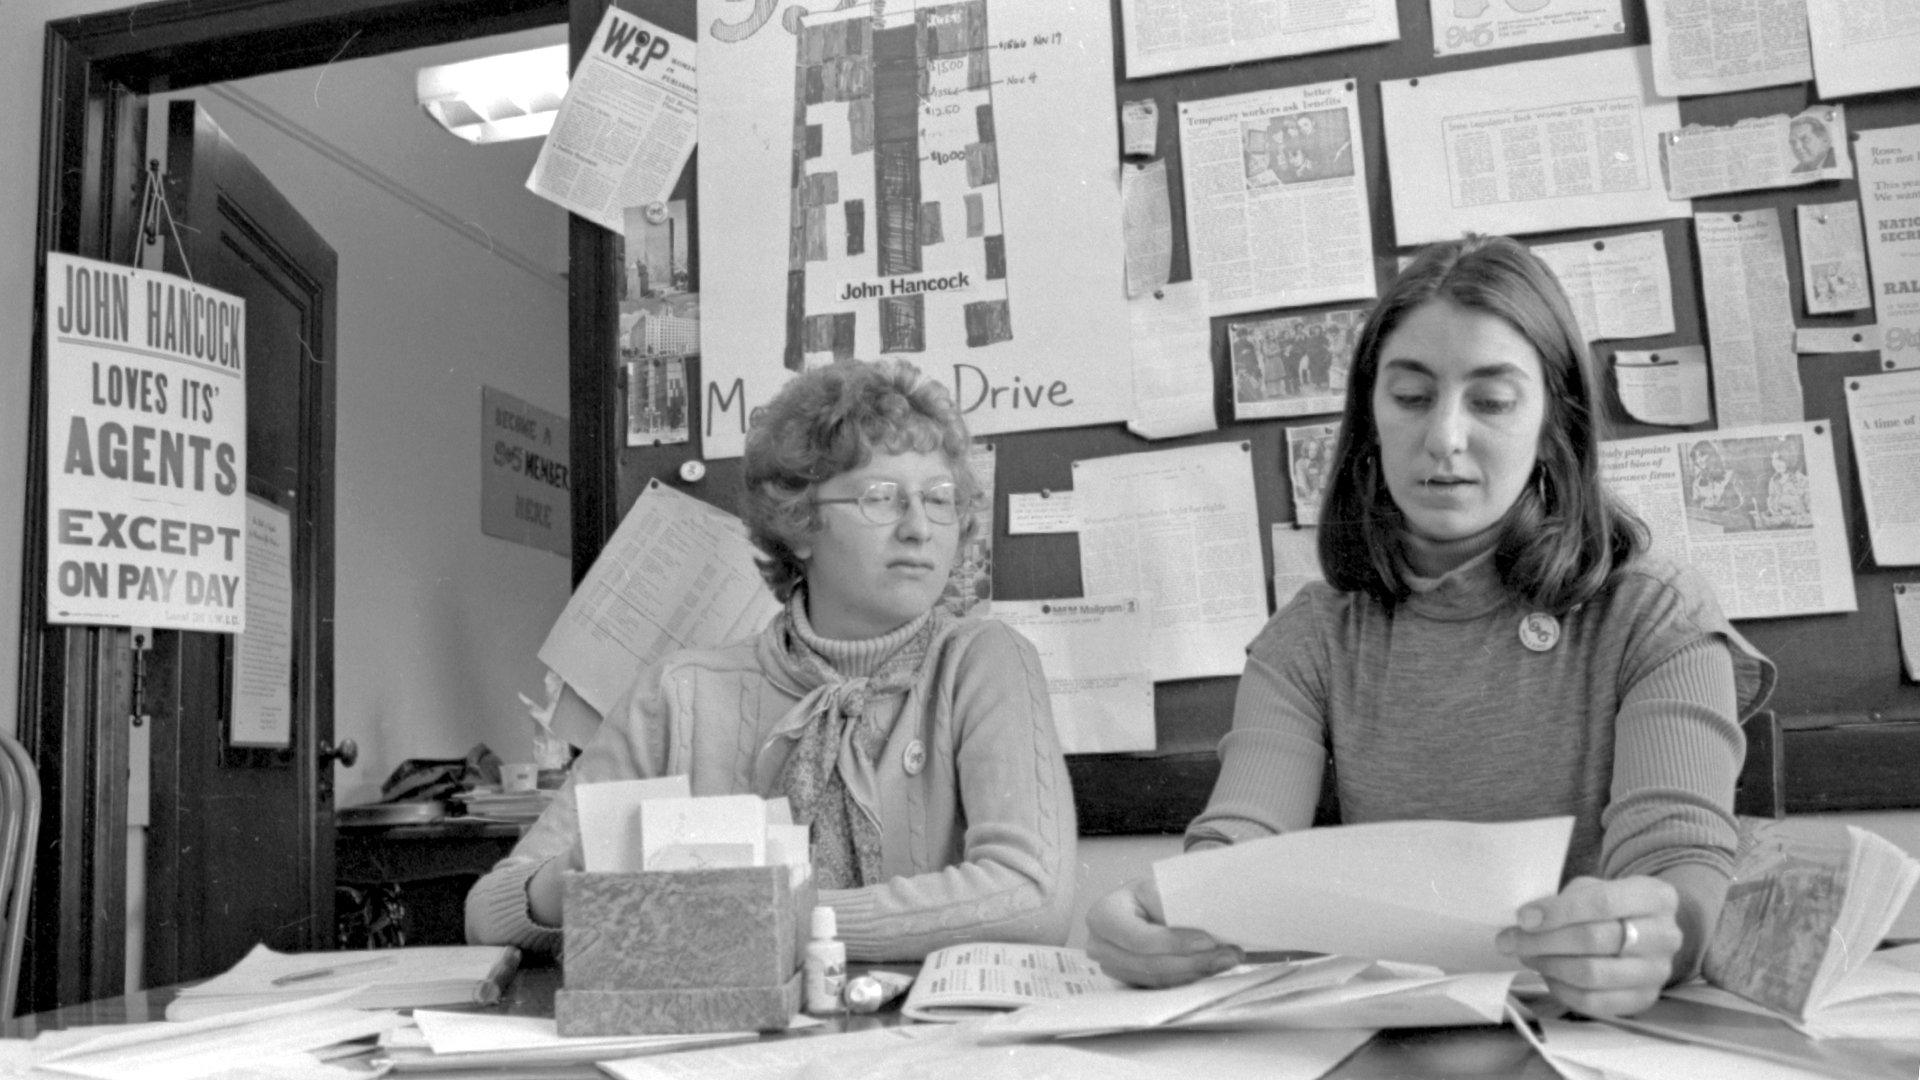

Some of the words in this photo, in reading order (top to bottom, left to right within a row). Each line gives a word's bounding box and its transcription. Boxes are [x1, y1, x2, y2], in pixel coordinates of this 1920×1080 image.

[1187, 111, 1239, 126] Temporary
[1241, 105, 1281, 118] workers
[1282, 101, 1299, 112] ask
[841, 282, 884, 300] John
[890, 271, 970, 295] Hancock
[56, 263, 130, 344] JOHN
[145, 279, 242, 370] HANCOCK
[92, 362, 168, 415] LOVES
[953, 363, 1074, 415] Drive
[1874, 417, 1900, 429] time
[1904, 414, 1916, 426] of
[64, 416, 238, 496] AGENTS
[524, 450, 570, 491] MEMBER
[1623, 444, 1672, 459] pinpoints
[57, 507, 241, 561] EXCEPT
[515, 495, 552, 530] HERE
[57, 559, 109, 600] ON
[117, 563, 178, 604] PAY
[184, 570, 240, 609] DAY
